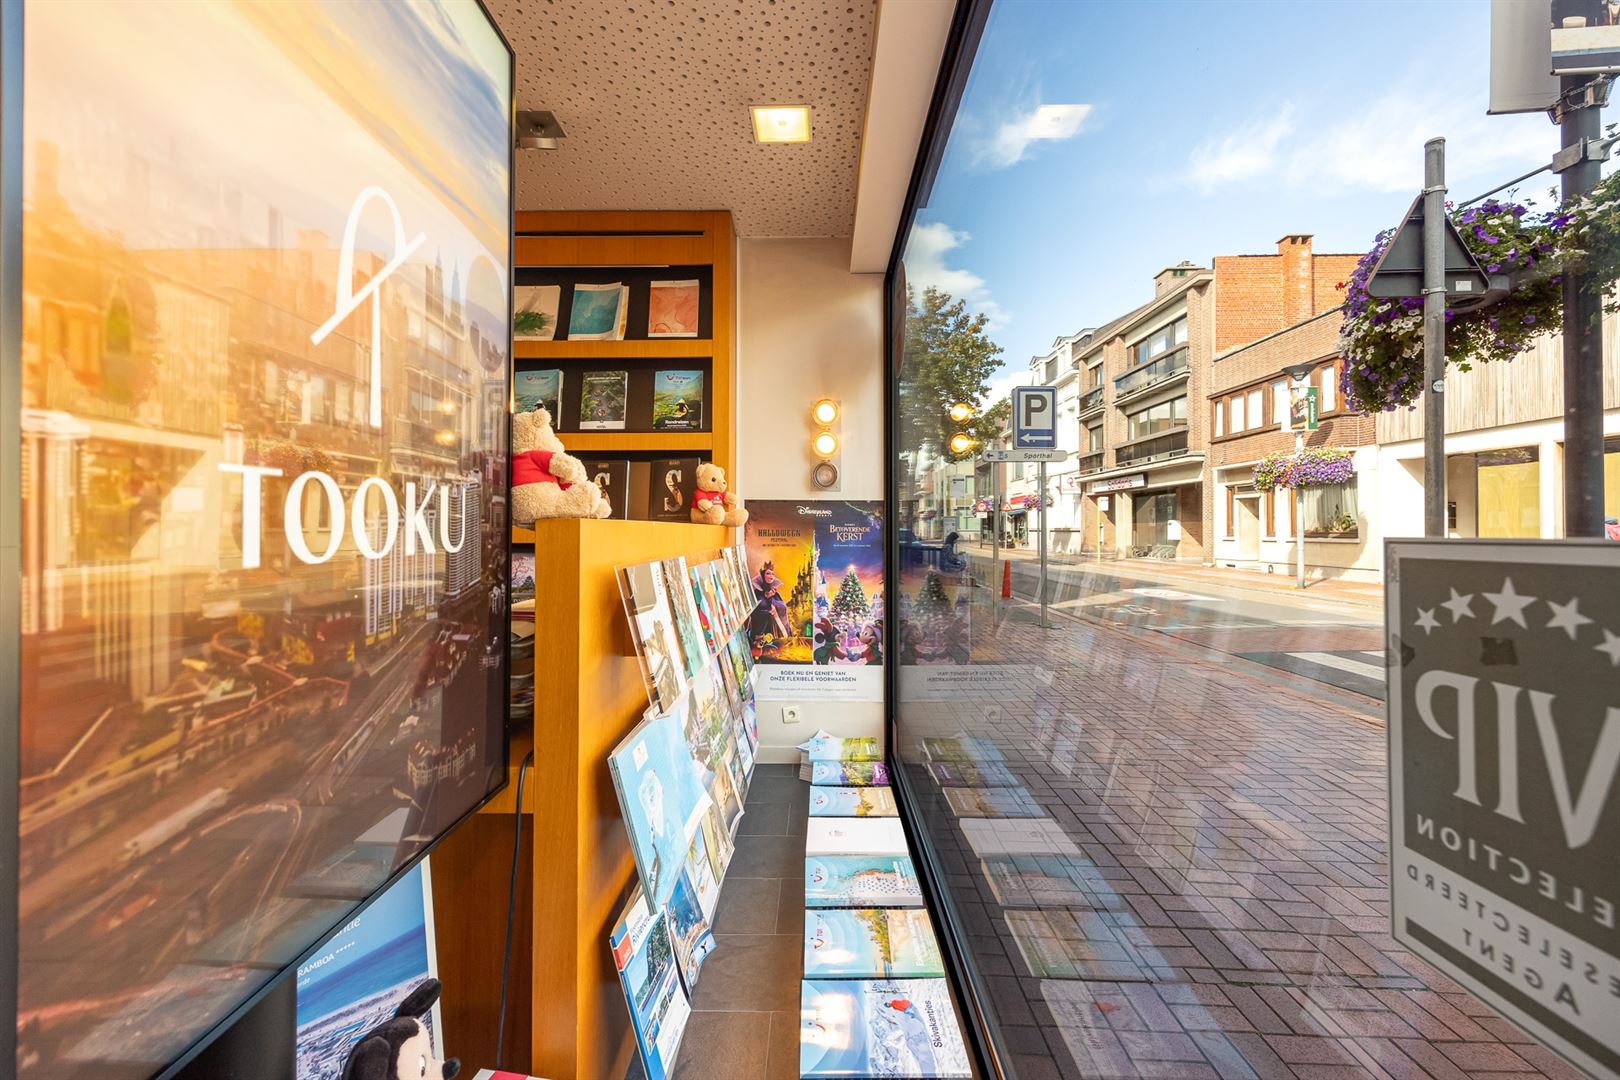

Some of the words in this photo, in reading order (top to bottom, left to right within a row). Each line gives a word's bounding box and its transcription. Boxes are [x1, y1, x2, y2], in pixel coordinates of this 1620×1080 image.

[1024, 394, 1048, 427] P
[1023, 452, 1053, 460] Sporthal
[217, 463, 466, 568] TOOKU
[758, 529, 801, 537] HALLOWEEN
[836, 532, 864, 543] KERST
[924, 999, 943, 1048] Skivakanties
